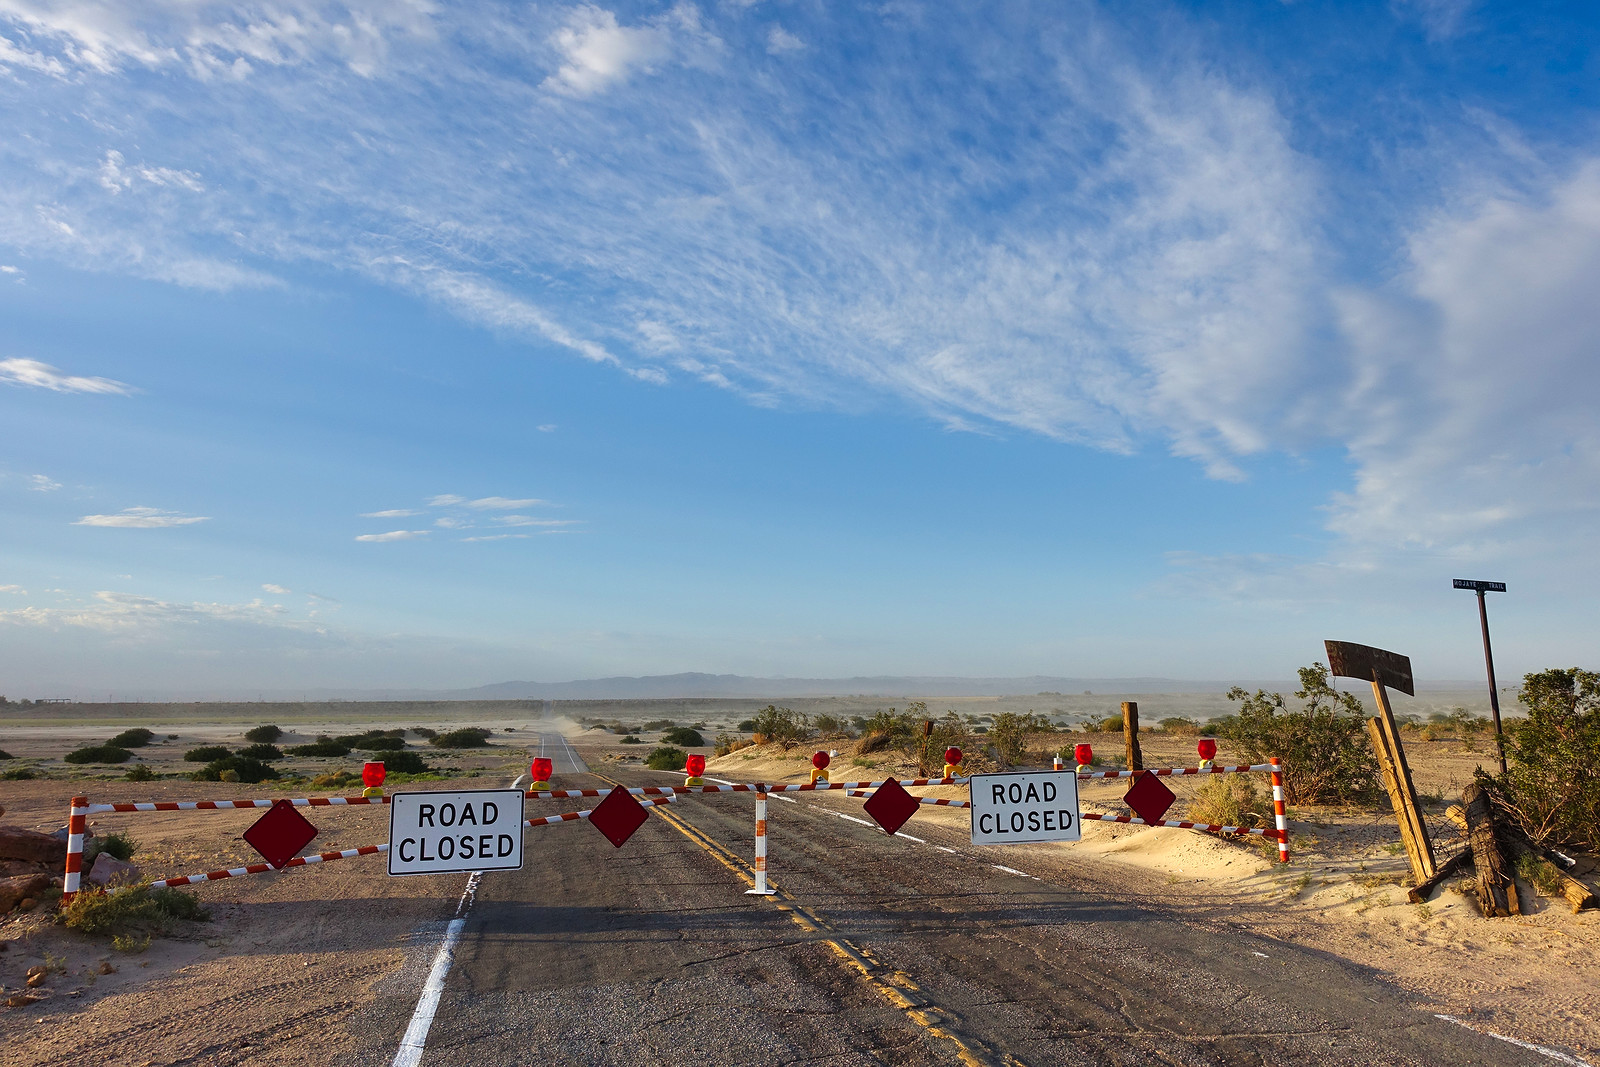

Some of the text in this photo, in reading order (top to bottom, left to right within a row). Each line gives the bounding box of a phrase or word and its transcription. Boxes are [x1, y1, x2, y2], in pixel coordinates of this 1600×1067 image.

[1488, 582, 1504, 590] TRAIL
[991, 781, 1057, 805] ROAD
[418, 801, 499, 828] ROAD
[979, 809, 1073, 834] CLOSED
[399, 834, 514, 863] CLOSED
